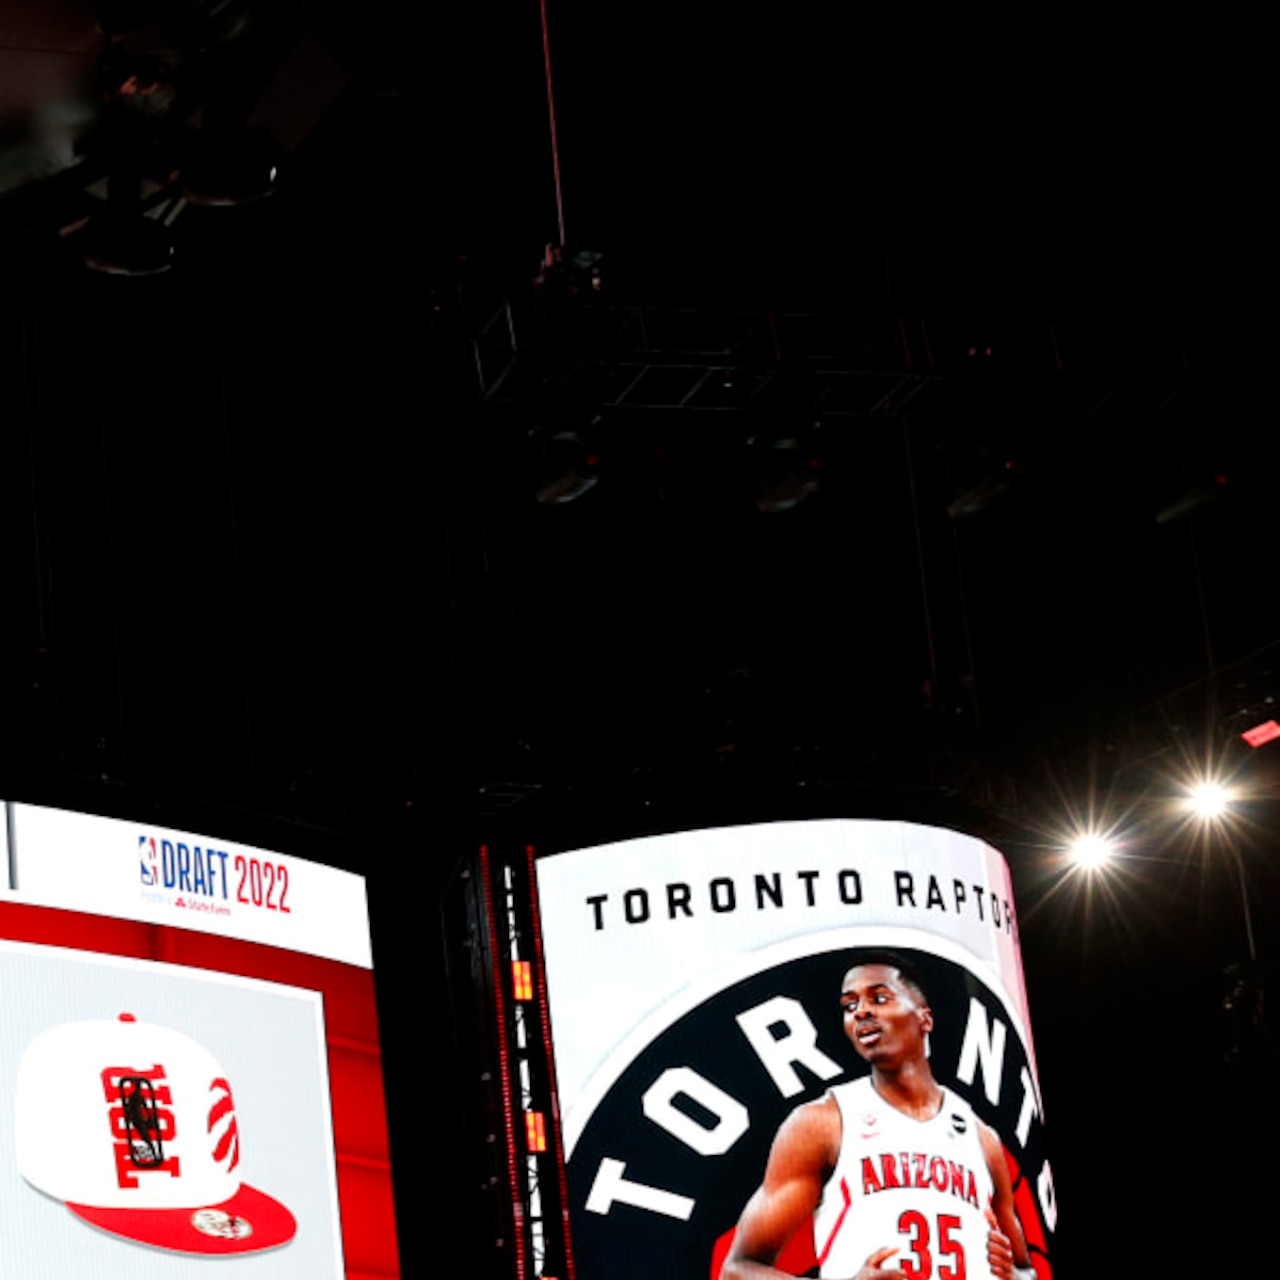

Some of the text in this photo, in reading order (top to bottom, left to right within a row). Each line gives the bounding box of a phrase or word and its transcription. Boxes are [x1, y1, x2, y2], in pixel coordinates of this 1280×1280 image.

[161, 838, 291, 914] DRAFT 2022
[586, 868, 862, 931] TORONTO
[585, 994, 1057, 1233] TORNTO
[861, 1152, 980, 1210] ARIZONA
